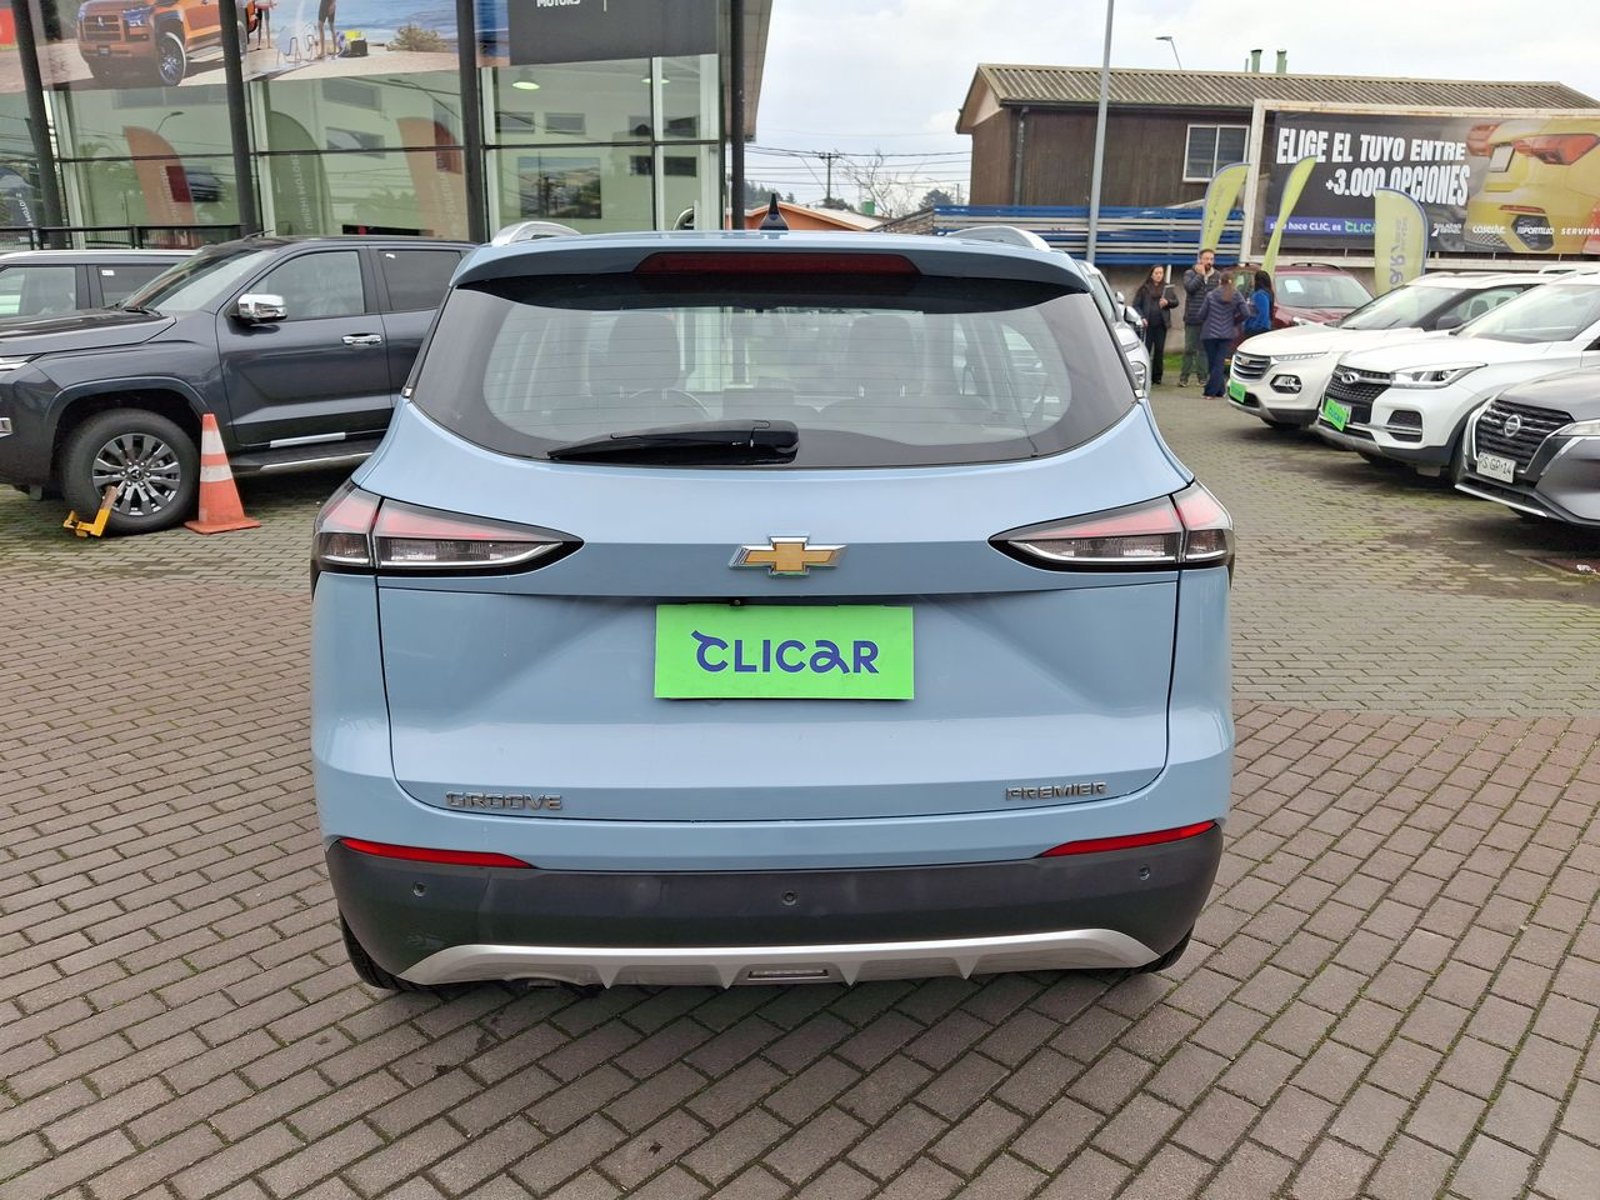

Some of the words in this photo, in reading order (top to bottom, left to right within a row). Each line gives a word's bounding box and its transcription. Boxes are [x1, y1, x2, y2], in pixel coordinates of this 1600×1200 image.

[1276, 127, 1329, 164] ELIGE
[1332, 132, 1353, 163] EL
[1360, 134, 1405, 162] TUYO
[1410, 139, 1466, 161] ENTRE
[1390, 165, 1470, 206] OPCIONES
[1288, 221, 1308, 230] hace
[446, 790, 563, 810] GROOVE
[1006, 781, 1107, 800] PREMIER
